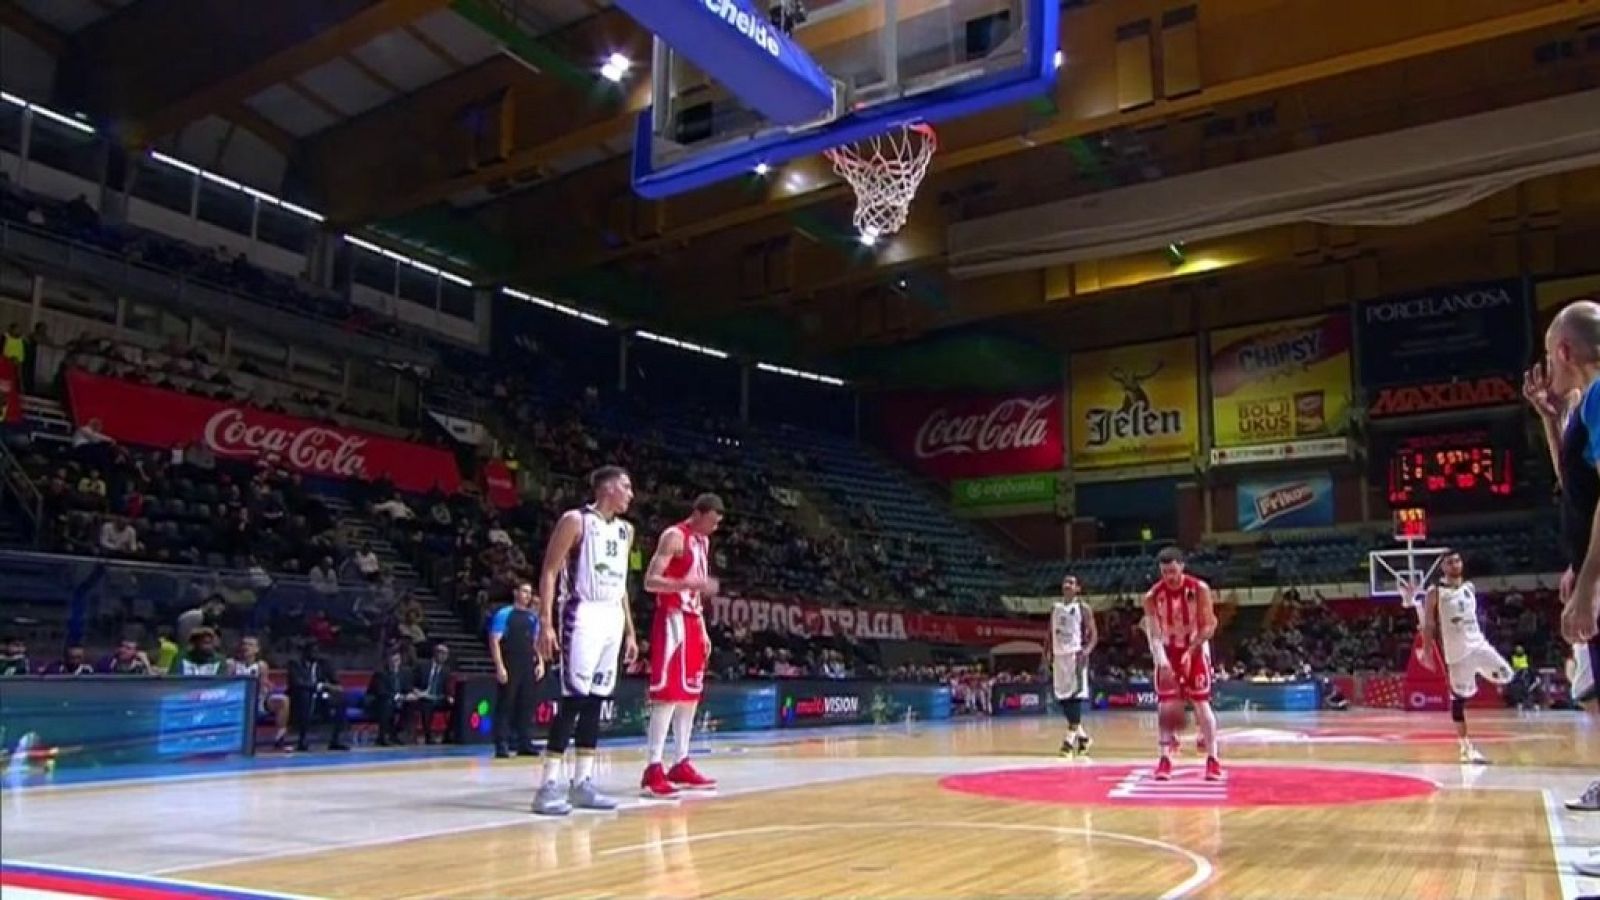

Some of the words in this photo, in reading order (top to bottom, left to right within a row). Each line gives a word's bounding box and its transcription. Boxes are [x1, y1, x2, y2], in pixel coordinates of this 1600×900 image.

[1366, 288, 1510, 324] PORCELANOSA
[1374, 377, 1516, 414] MAXIMA
[204, 408, 368, 477] Coca-Cola
[915, 395, 1055, 459] Coca-Cola
[1085, 401, 1182, 447] Jelen
[1239, 415, 1290, 433] UKUS
[605, 540, 618, 557] 33
